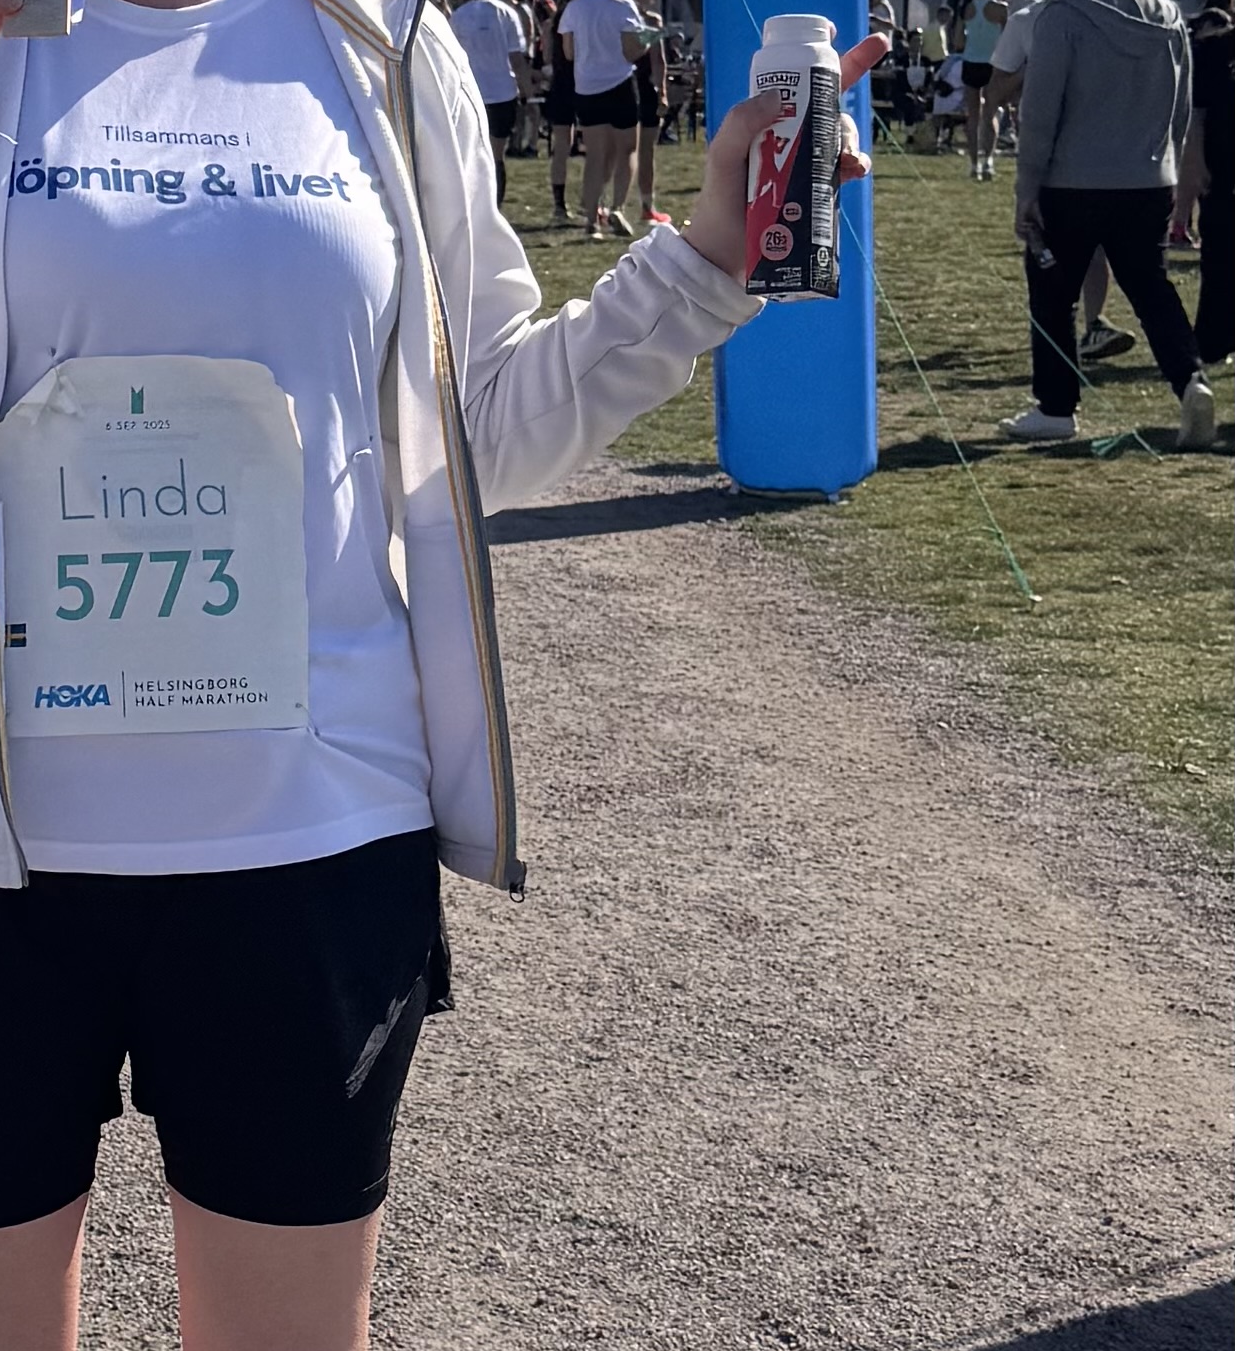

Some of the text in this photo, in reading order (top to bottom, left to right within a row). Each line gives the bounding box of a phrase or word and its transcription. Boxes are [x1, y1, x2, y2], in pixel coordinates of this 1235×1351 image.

[101, 124, 251, 147] Tillsammans i
[201, 163, 237, 197] &
[251, 161, 352, 204] livet
[105, 422, 112, 431] 6
[142, 419, 171, 431] 2025
[59, 458, 228, 521] Linda
[55, 549, 240, 621] 5773
[33, 683, 112, 709] HOKA
[134, 677, 249, 693] HELSINGBORG
[134, 691, 269, 708] HALF MARATHON
